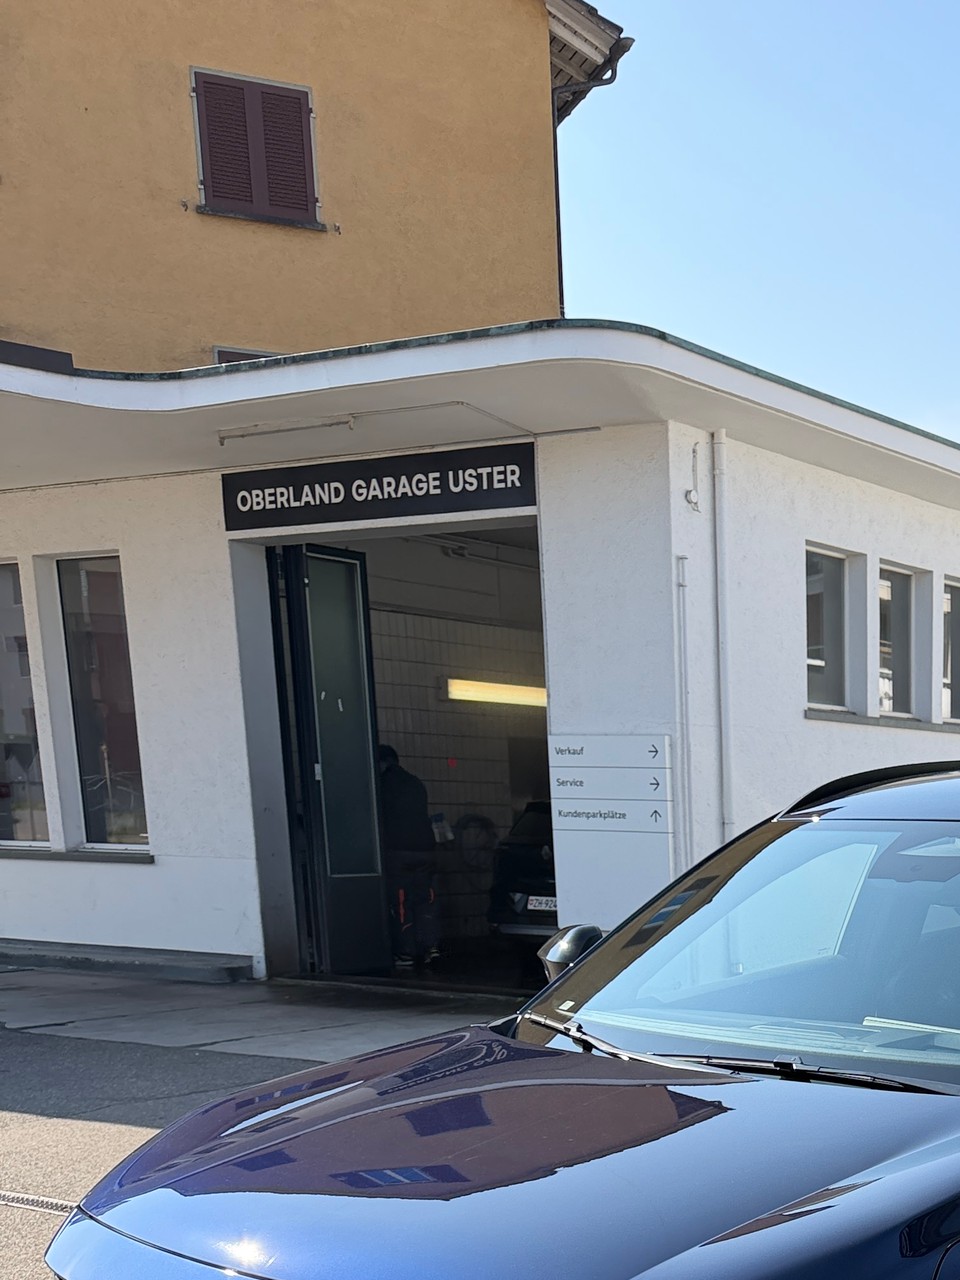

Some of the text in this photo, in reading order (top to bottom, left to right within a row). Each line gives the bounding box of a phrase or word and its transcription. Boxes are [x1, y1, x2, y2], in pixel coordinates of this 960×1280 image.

[237, 464, 521, 511] OBERLAND GARAGE USTER
[554, 746, 584, 756] Verkauf
[556, 778, 584, 787] Service
[558, 809, 627, 820] Kundenparkplätze
